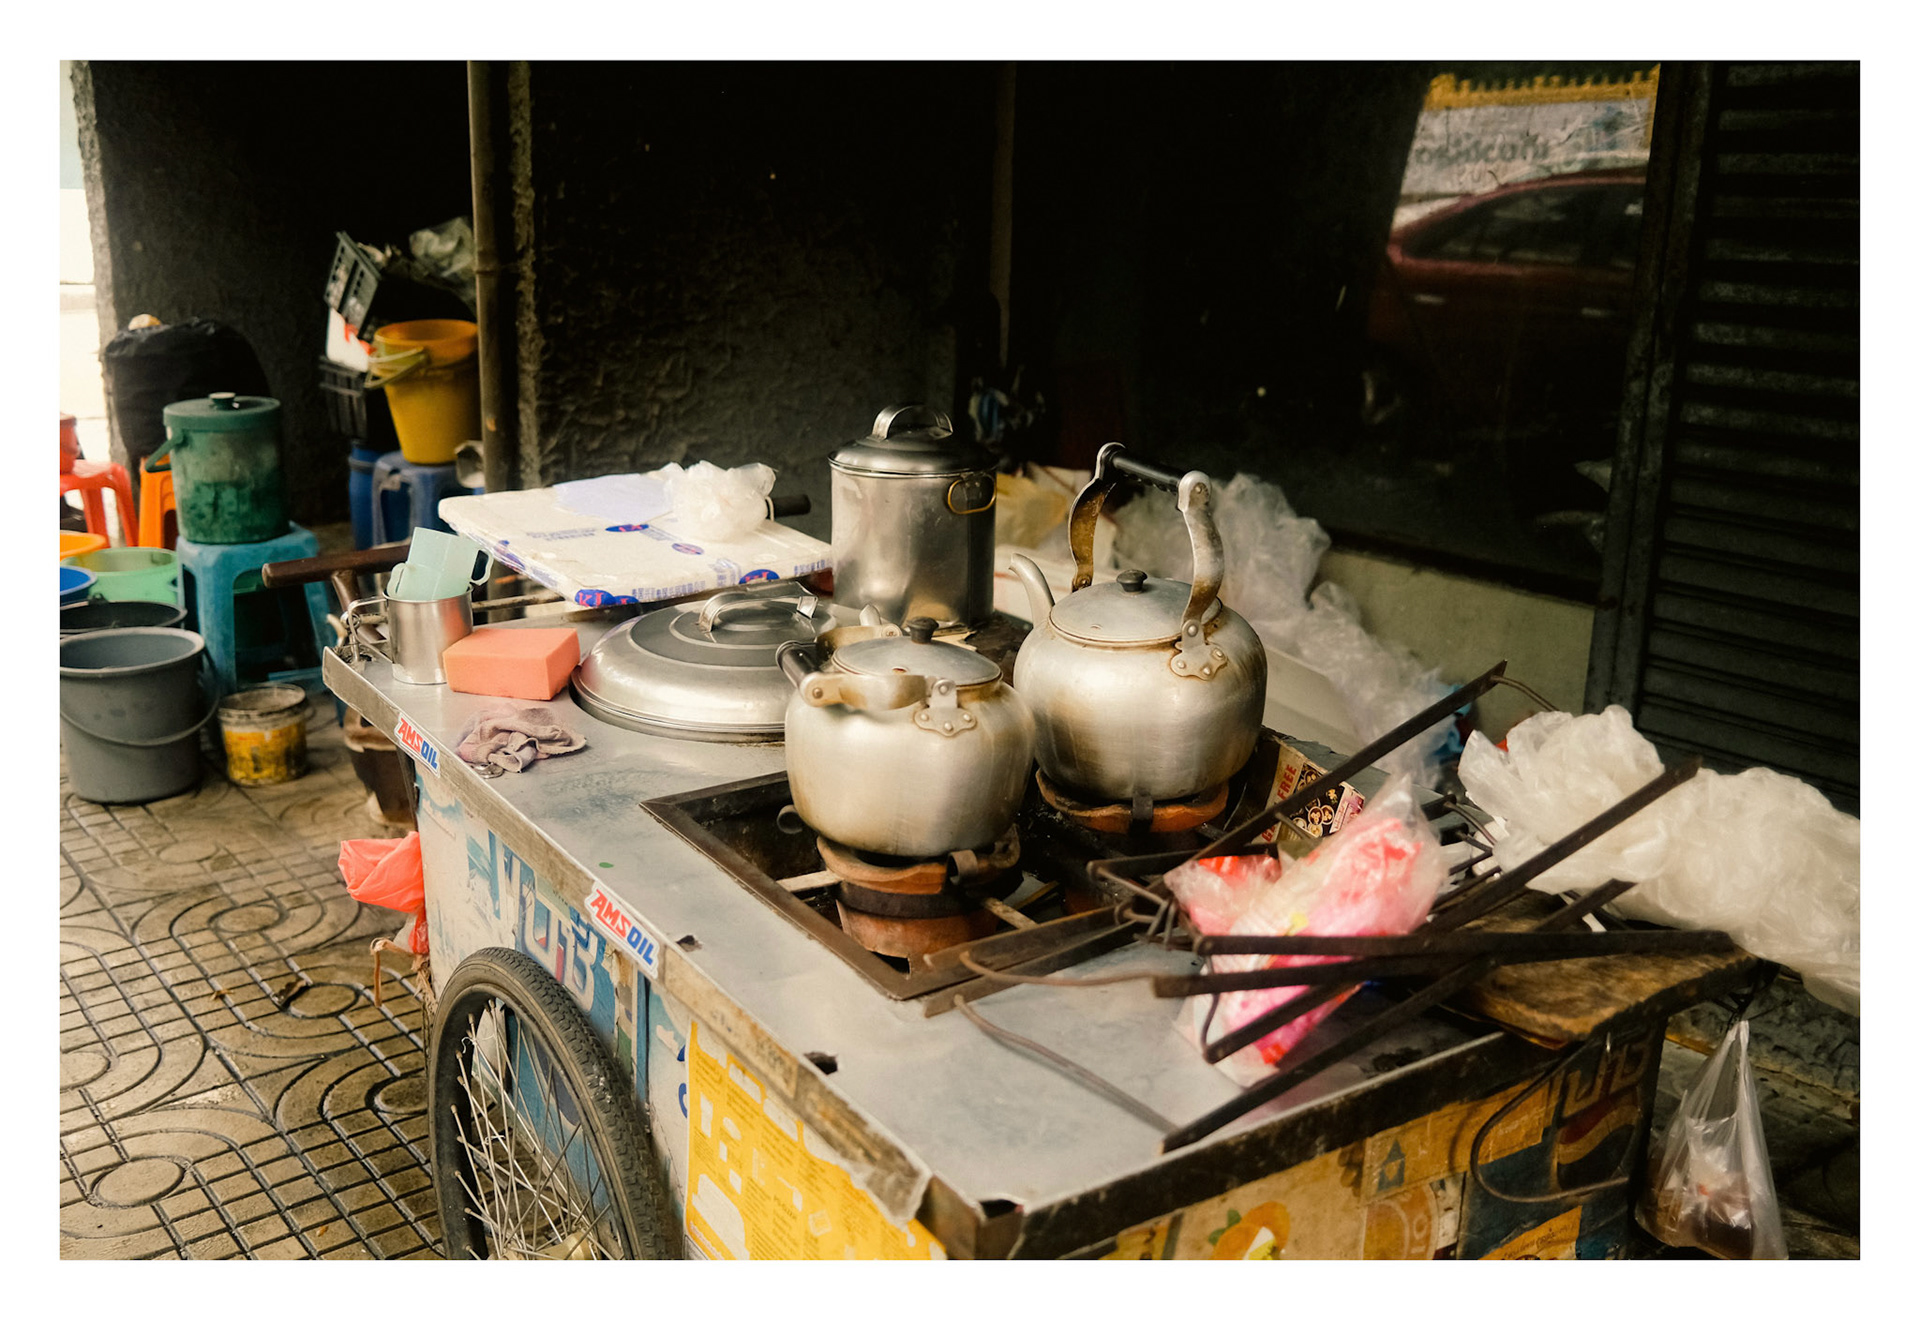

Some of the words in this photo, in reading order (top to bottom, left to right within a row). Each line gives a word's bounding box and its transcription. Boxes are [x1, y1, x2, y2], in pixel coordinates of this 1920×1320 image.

[398, 717, 437, 770] AMSOIL
[1278, 764, 1297, 800] FREE
[590, 888, 654, 966] AMSOIL
